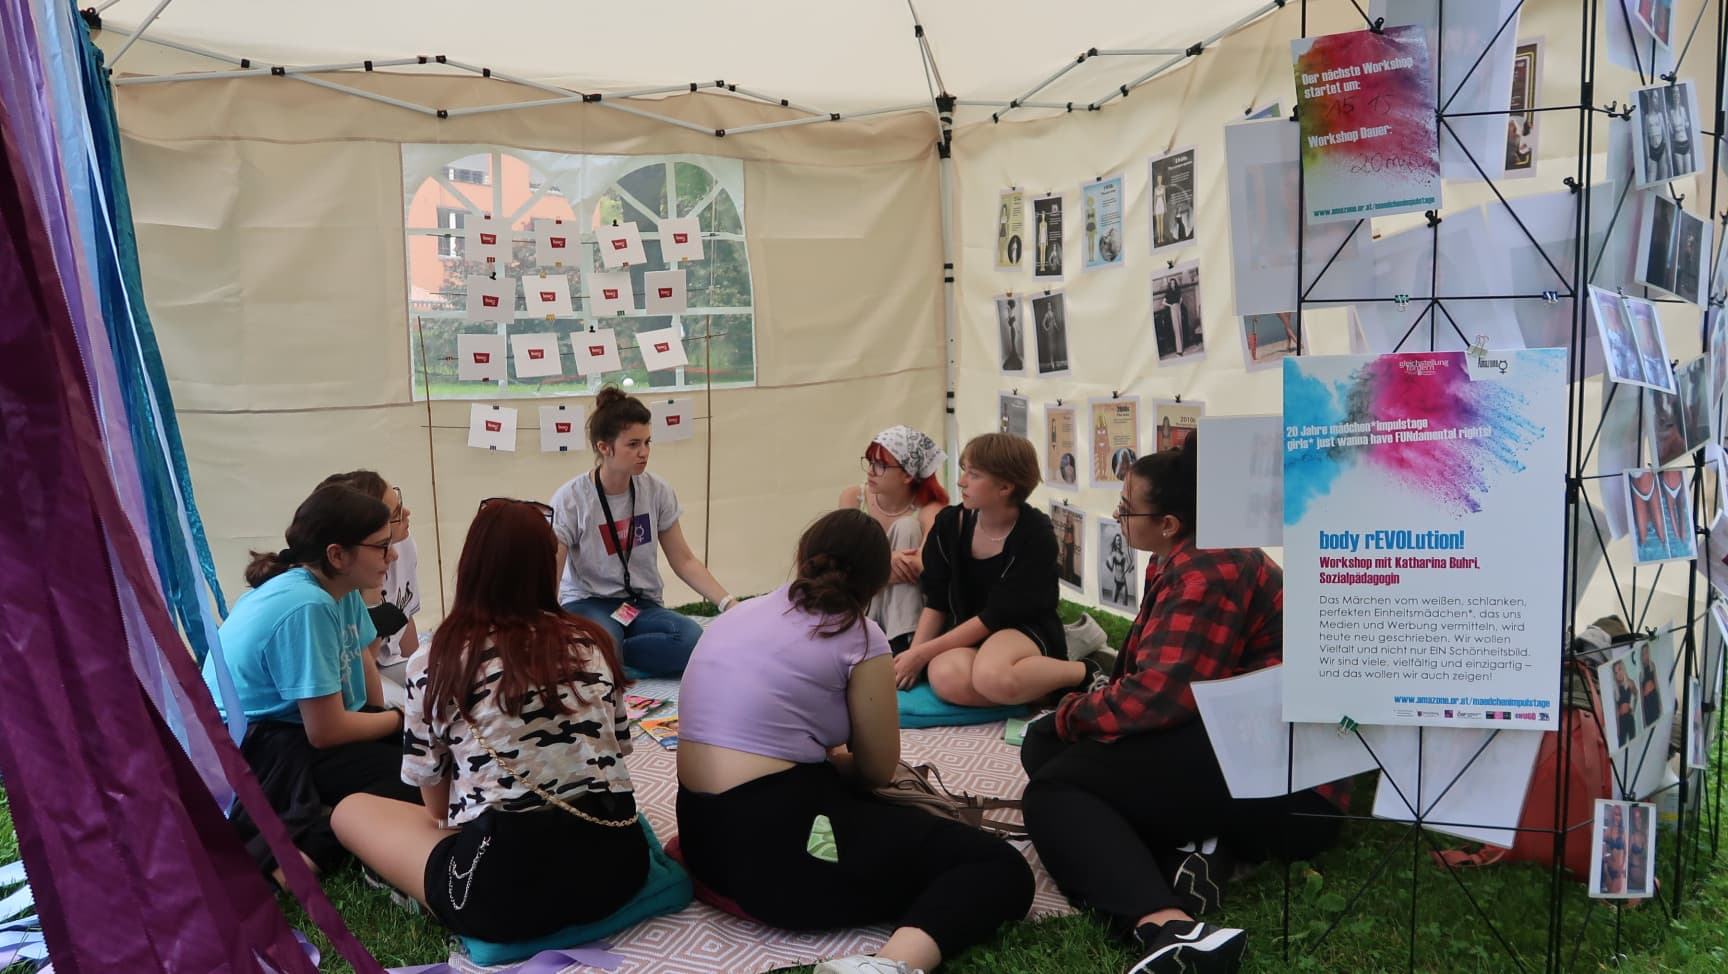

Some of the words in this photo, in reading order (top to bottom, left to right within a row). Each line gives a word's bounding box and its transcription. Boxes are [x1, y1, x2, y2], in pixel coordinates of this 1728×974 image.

[1301, 73, 1319, 85] Der
[1322, 66, 1360, 81] nächste
[1362, 57, 1414, 74] Workshop
[1304, 82, 1341, 99] startet
[1343, 80, 1361, 92] um:
[1308, 130, 1358, 148] Workshop
[1360, 125, 1393, 140] Dauer:
[1286, 426, 1298, 437] 20
[1301, 425, 1328, 436] Jahre
[1316, 437, 1335, 449] just
[1337, 435, 1369, 447] wanna
[1370, 433, 1393, 444] have
[1395, 428, 1456, 443] FUNdamental
[1320, 530, 1360, 552] body
[1365, 530, 1465, 550] rEVOLution!
[1320, 556, 1372, 570] Workshop
[1375, 556, 1392, 569] mit
[1395, 556, 1446, 569] Katharina
[1449, 556, 1481, 569] Buhri,
[1320, 572, 1400, 586] Sozialpädagogin
[1320, 595, 1339, 605] Das
[1343, 595, 1391, 605] Märchen
[1394, 597, 1419, 605] vom
[1467, 597, 1527, 607] schlanken,
[1320, 607, 1371, 618] perfekten
[1480, 609, 1500, 619] das
[1503, 611, 1521, 619] uns
[1320, 620, 1359, 629] Medien
[1363, 621, 1384, 630] und
[1387, 621, 1438, 632] Werbung
[1441, 622, 1498, 632] vermitteln,
[1501, 622, 1525, 632] wird
[1320, 632, 1351, 641] heute
[1354, 634, 1375, 642] neu
[1378, 633, 1450, 644] geschrieben.
[1454, 634, 1471, 643] Wir
[1474, 635, 1511, 644] wollen
[1320, 644, 1354, 653] Vielfalt
[1357, 645, 1378, 654] und
[1380, 646, 1407, 655] nicht
[1410, 647, 1427, 655] nur
[1430, 646, 1447, 655] EIN
[1320, 656, 1335, 665] Wir
[1338, 656, 1359, 666] sind
[1361, 657, 1390, 667] viele,
[1393, 658, 1438, 669] vielfältig
[1441, 659, 1462, 668] und
[1465, 660, 1522, 671] einzigartig
[1319, 668, 1340, 678] und
[1342, 669, 1362, 678] das
[1364, 669, 1400, 679] wollen
[1402, 670, 1418, 679] wir
[1420, 671, 1450, 680] auch
[1452, 672, 1492, 683] zeigen!
